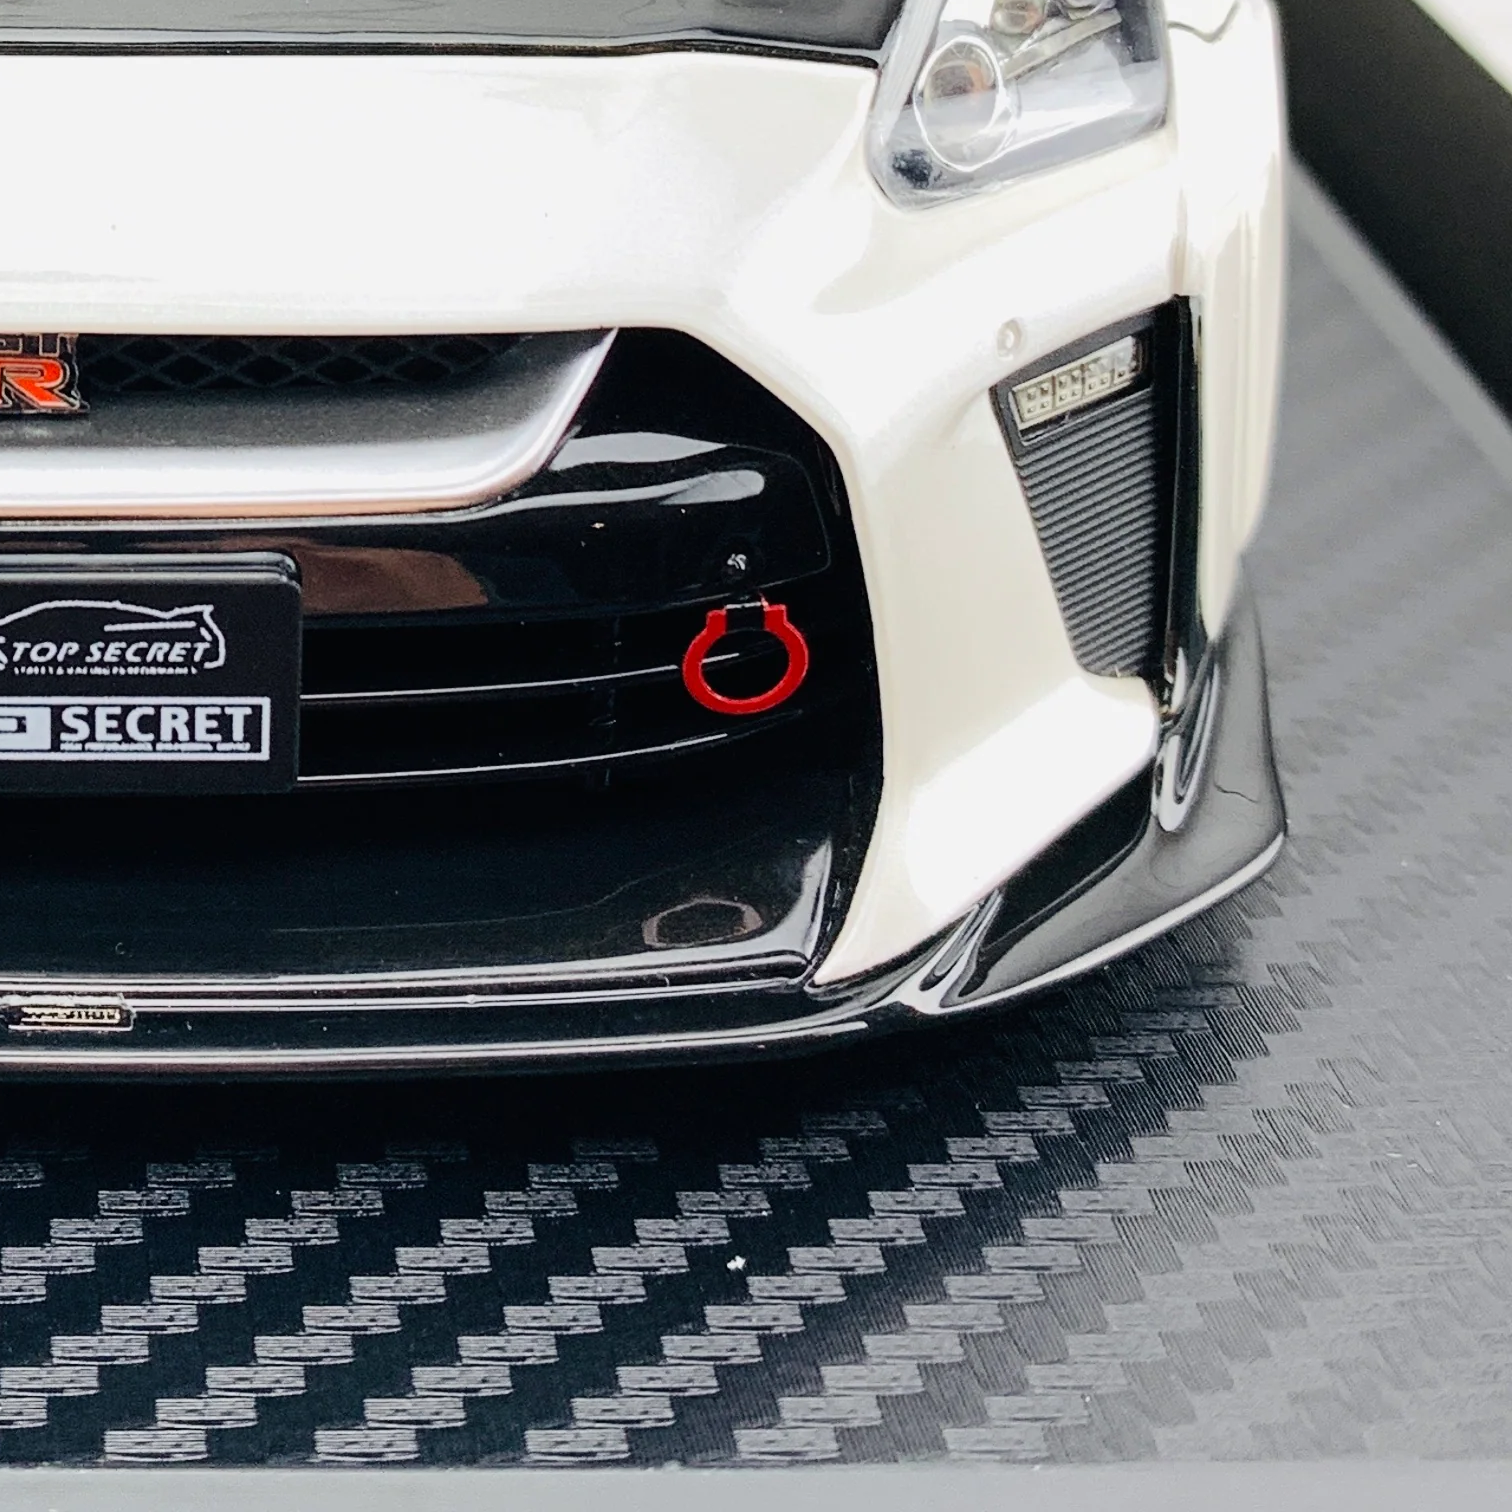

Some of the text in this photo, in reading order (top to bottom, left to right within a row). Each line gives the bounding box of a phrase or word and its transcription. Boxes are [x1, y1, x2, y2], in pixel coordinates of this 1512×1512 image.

[12, 641, 211, 663] TOP SECRET
[59, 706, 253, 742] SECRET
